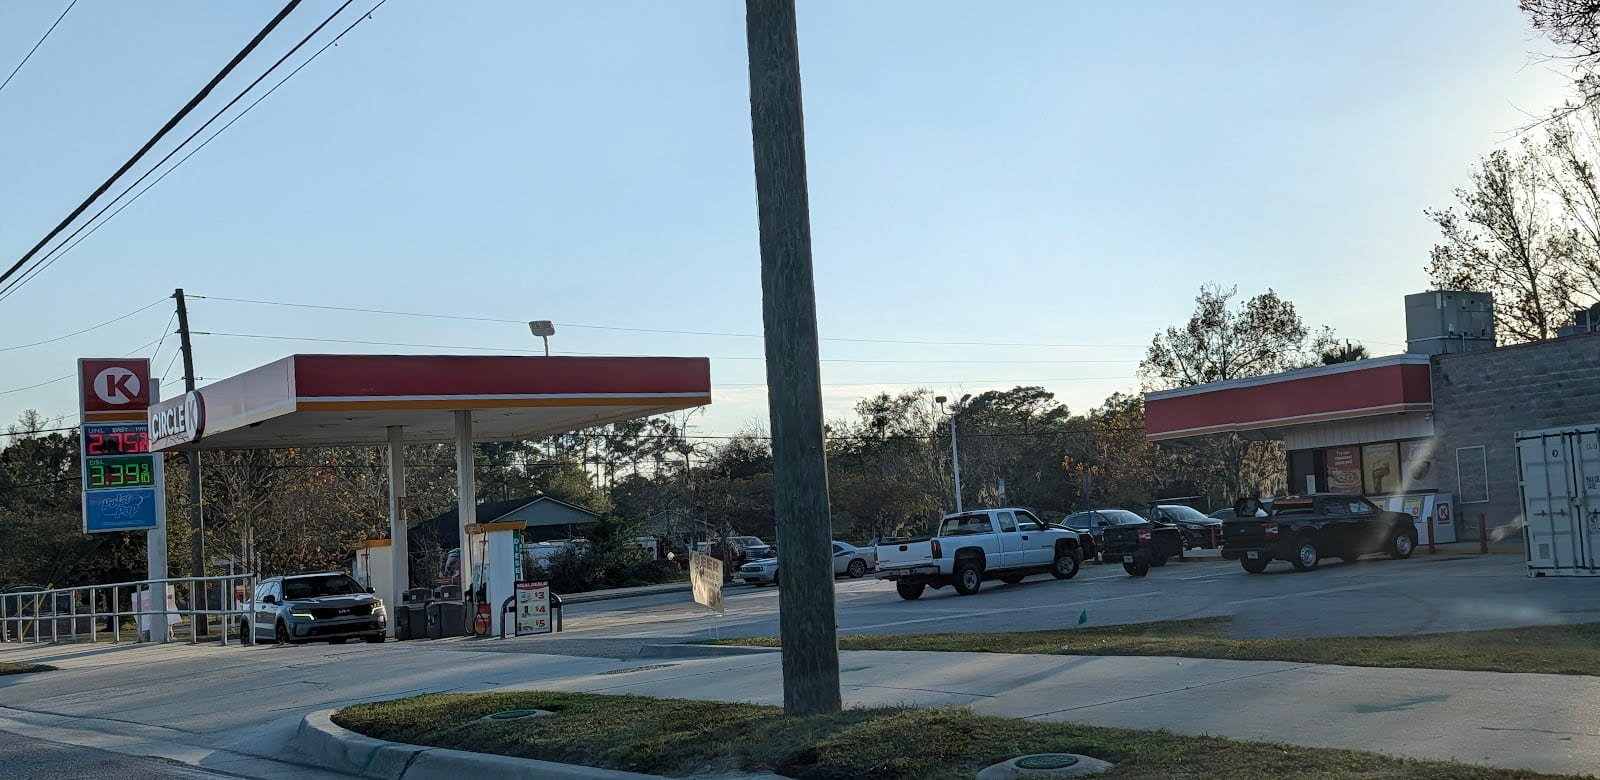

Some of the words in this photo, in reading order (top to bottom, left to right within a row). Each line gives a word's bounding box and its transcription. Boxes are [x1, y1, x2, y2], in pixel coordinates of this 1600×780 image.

[106, 374, 137, 402] K
[152, 404, 185, 440] CIRCLE
[88, 433, 139, 455] 2.75
[91, 463, 140, 486] 3.39
[513, 538, 521, 581] DIESEL
